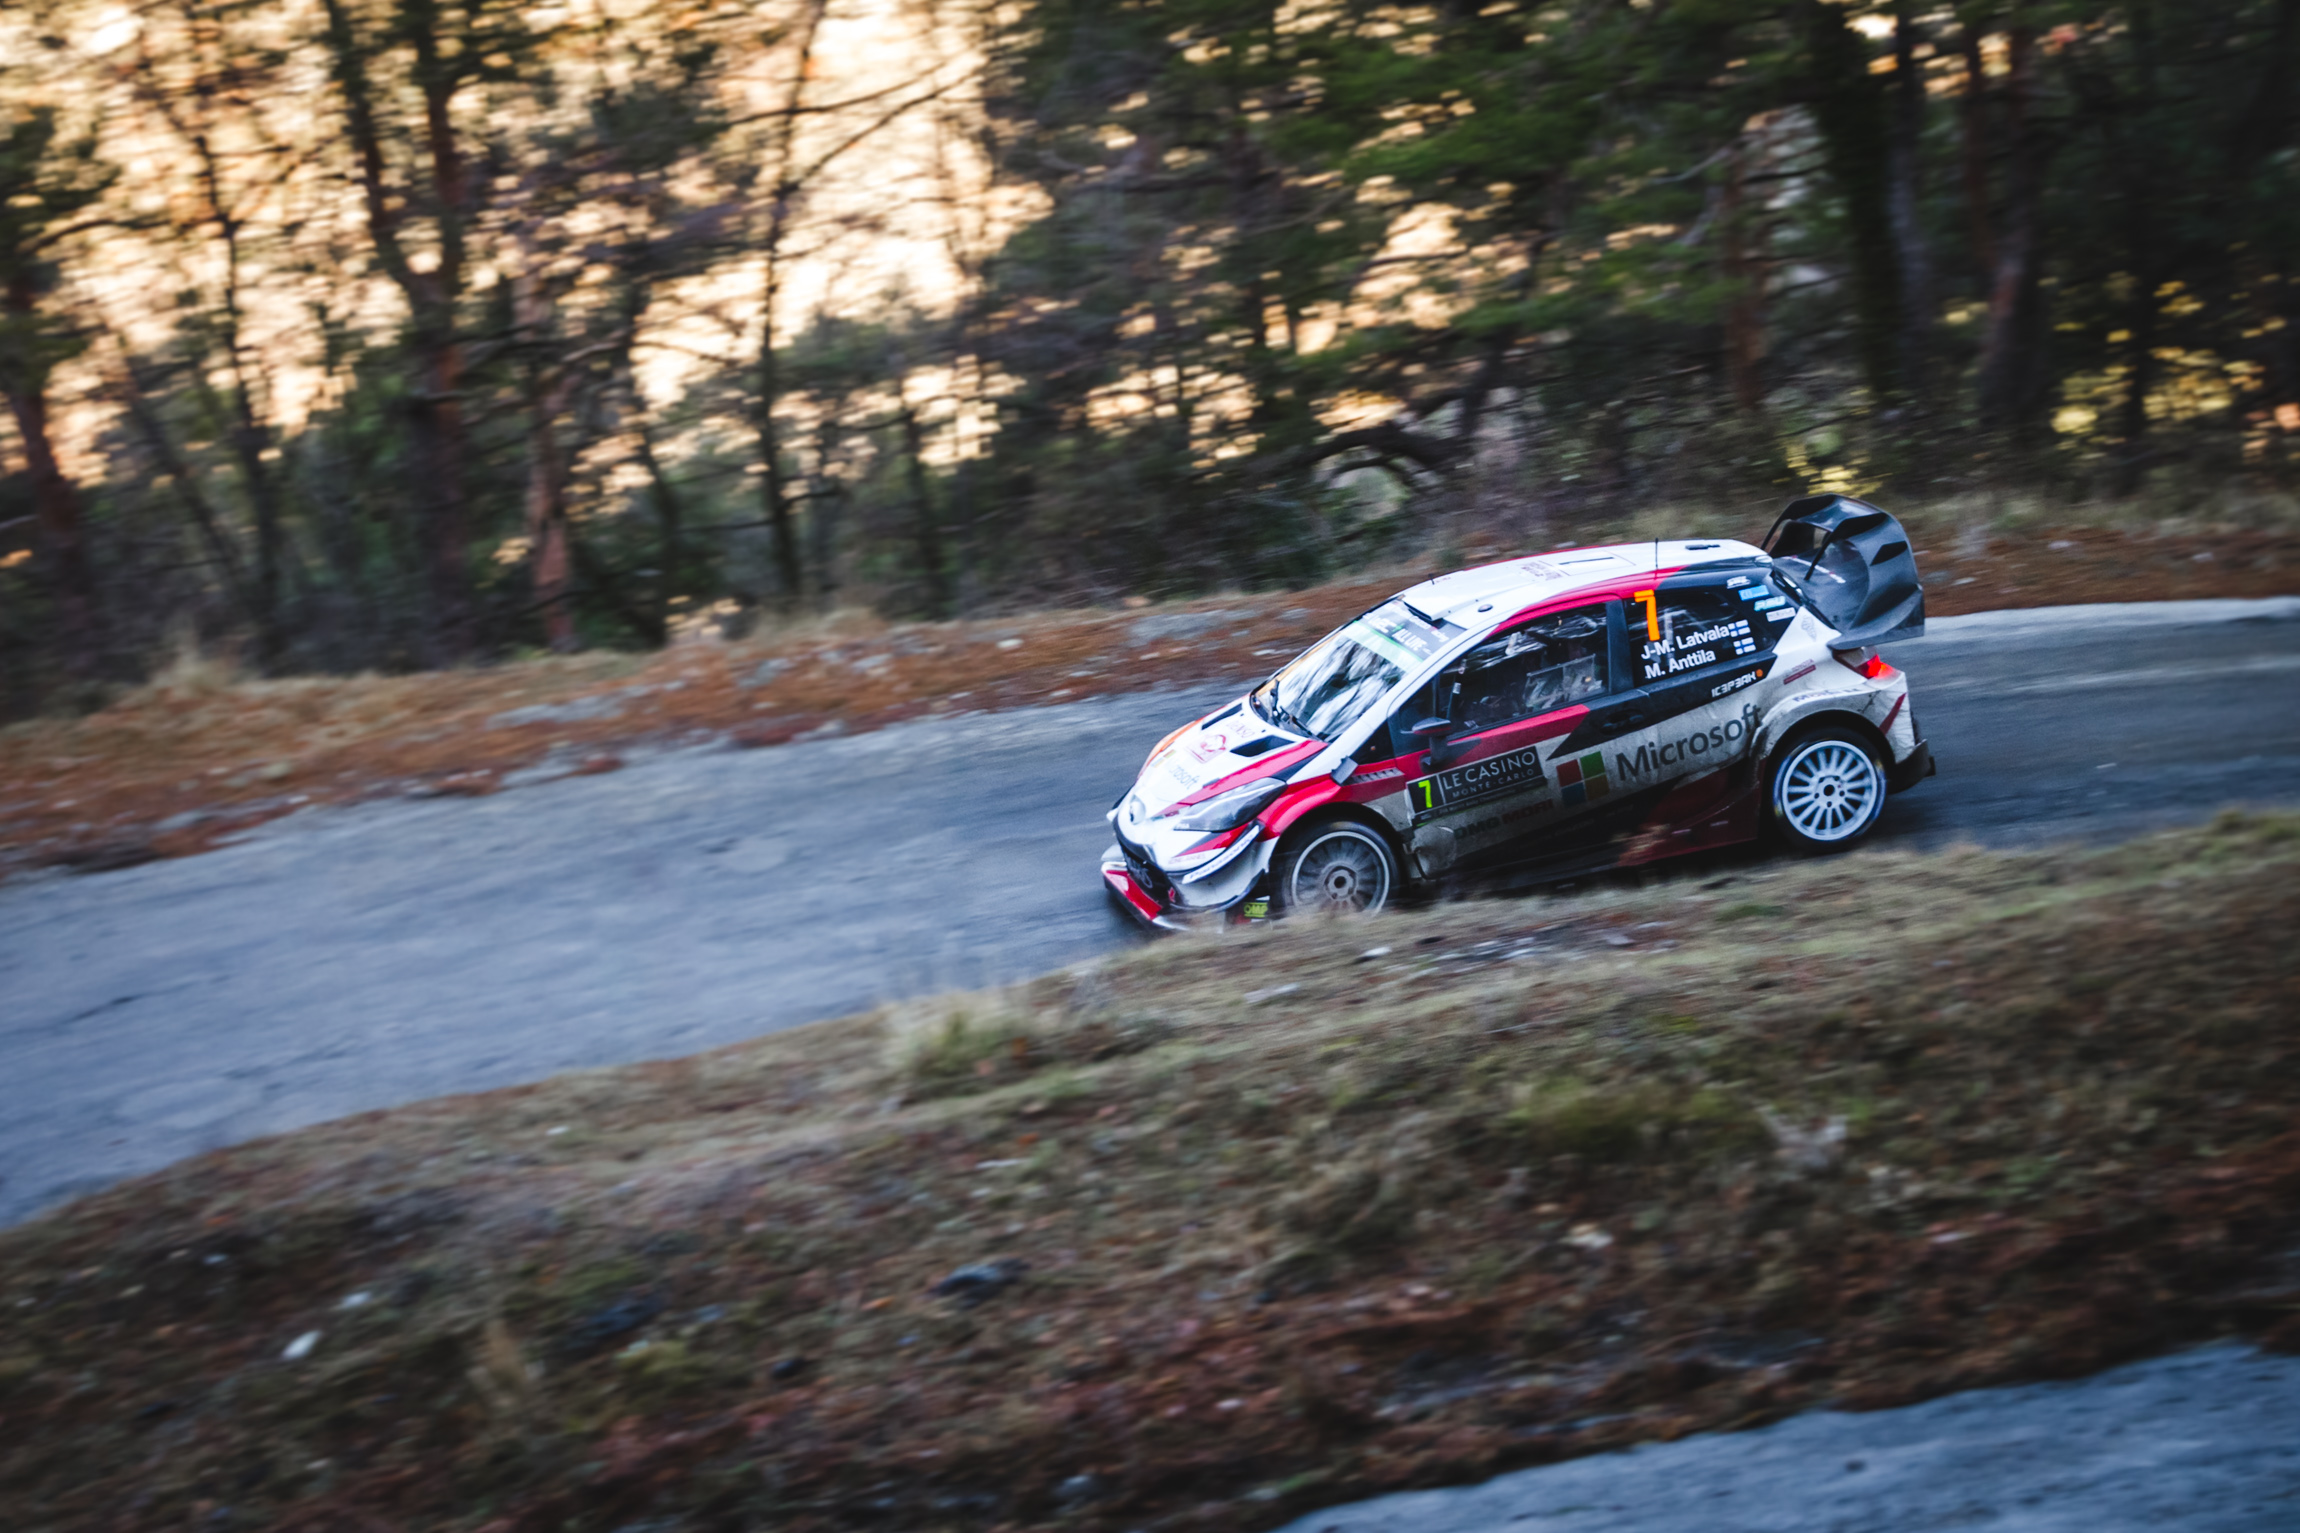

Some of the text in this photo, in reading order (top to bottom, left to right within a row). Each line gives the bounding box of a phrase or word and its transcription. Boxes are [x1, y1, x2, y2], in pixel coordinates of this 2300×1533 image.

[1633, 589, 1660, 641] 7
[1641, 624, 1730, 659] J-M. Latvala
[1644, 649, 1716, 679] M. Anttila
[1615, 703, 1761, 781] Microsoft
[1442, 751, 1536, 790] LE CASINO
[1418, 780, 1432, 808] 7
